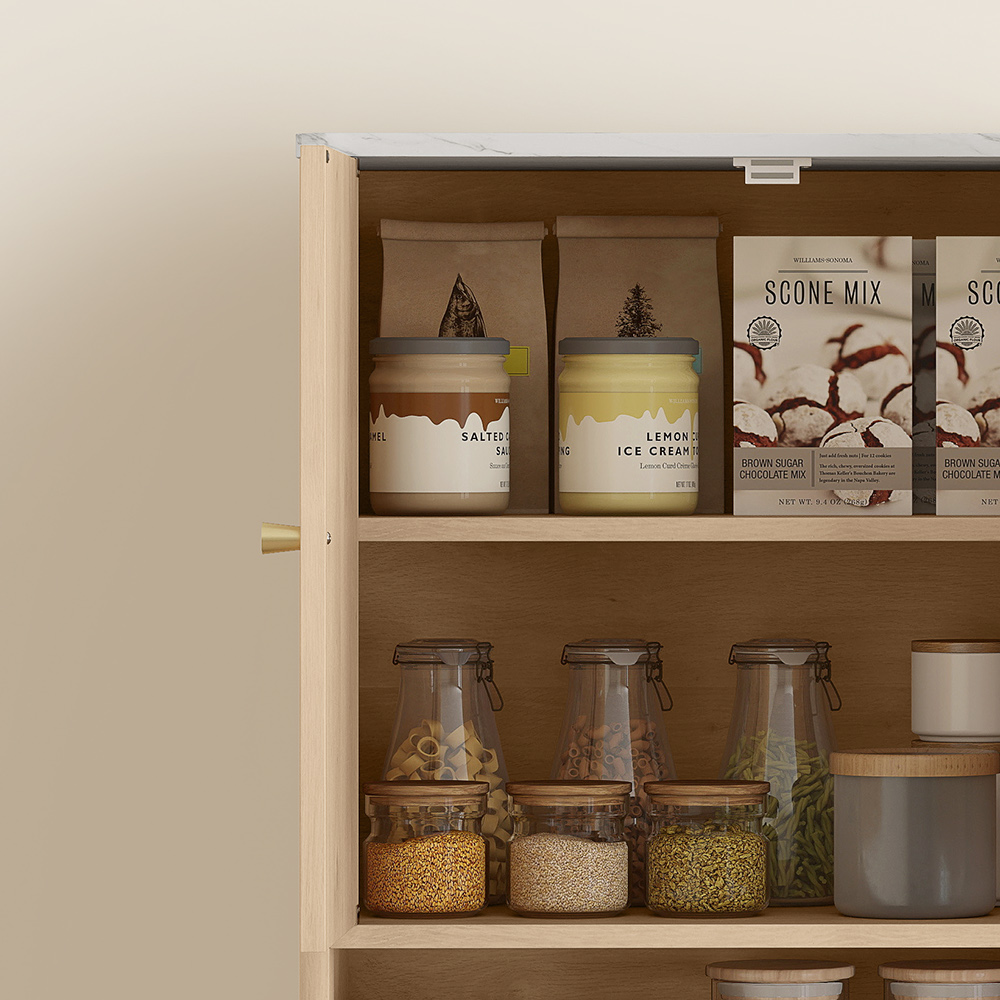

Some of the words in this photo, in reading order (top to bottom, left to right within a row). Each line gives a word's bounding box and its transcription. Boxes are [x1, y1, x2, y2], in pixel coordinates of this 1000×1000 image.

[765, 280, 834, 305] SCONE
[844, 280, 882, 305] MIX
[461, 432, 504, 441] SALTED
[646, 432, 689, 441] LEMON
[617, 446, 642, 456] ICE
[649, 446, 690, 456] CREAM
[741, 458, 773, 468] BROWN
[775, 458, 804, 468] SUGAR
[944, 458, 976, 468] BROWN
[739, 469, 788, 479] CHOCOLATE
[790, 469, 807, 479] MIX
[942, 469, 991, 479] CHOCOLATE
